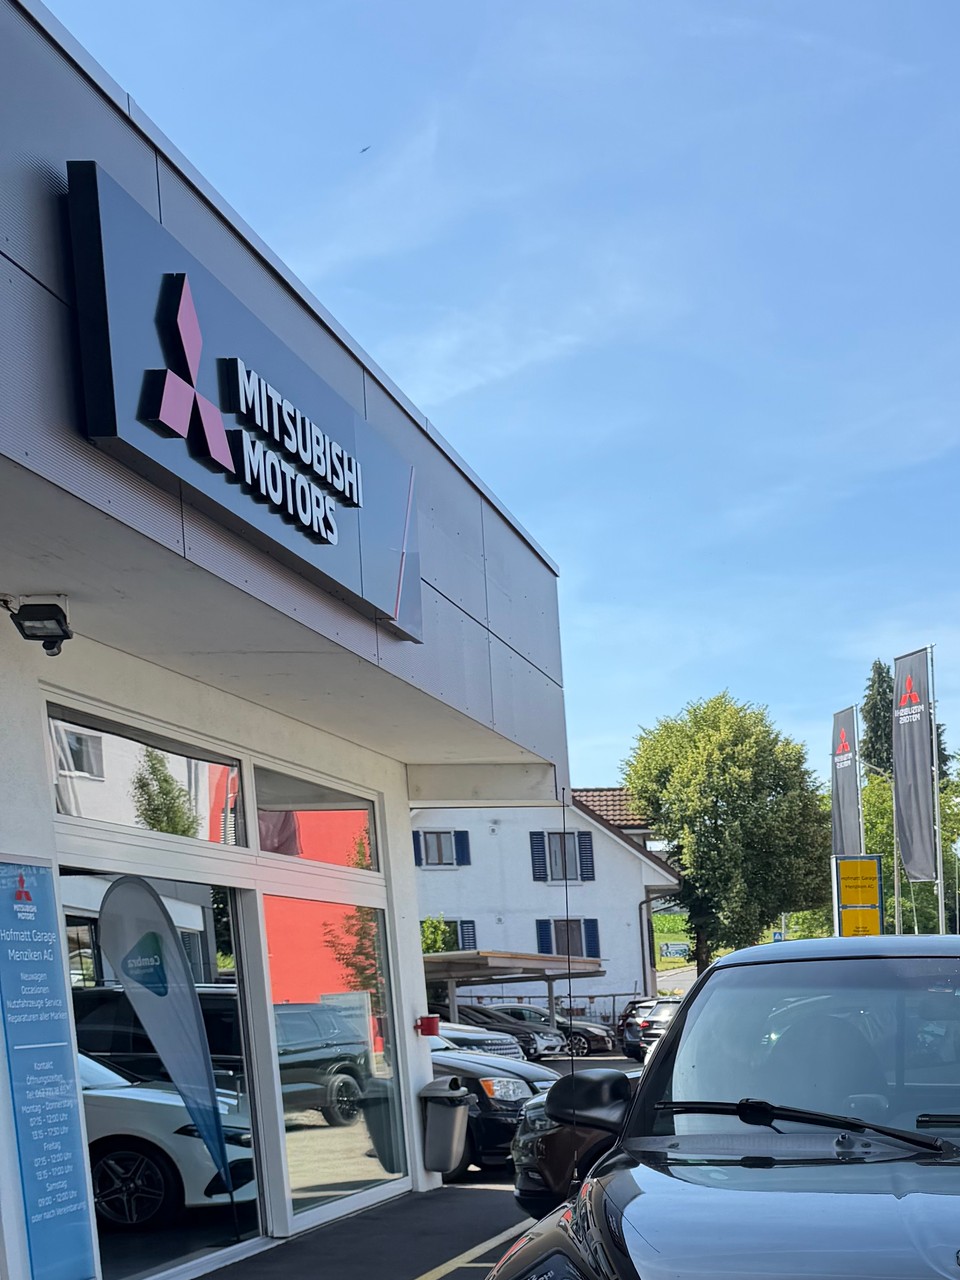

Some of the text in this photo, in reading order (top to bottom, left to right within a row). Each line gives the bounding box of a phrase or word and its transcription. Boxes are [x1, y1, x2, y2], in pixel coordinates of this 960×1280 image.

[237, 357, 363, 508] MITSUBISHI
[242, 429, 338, 546] MOTORS
[0, 929, 56, 945] Hofmatt Garage
[8, 949, 53, 961] Menziken AG
